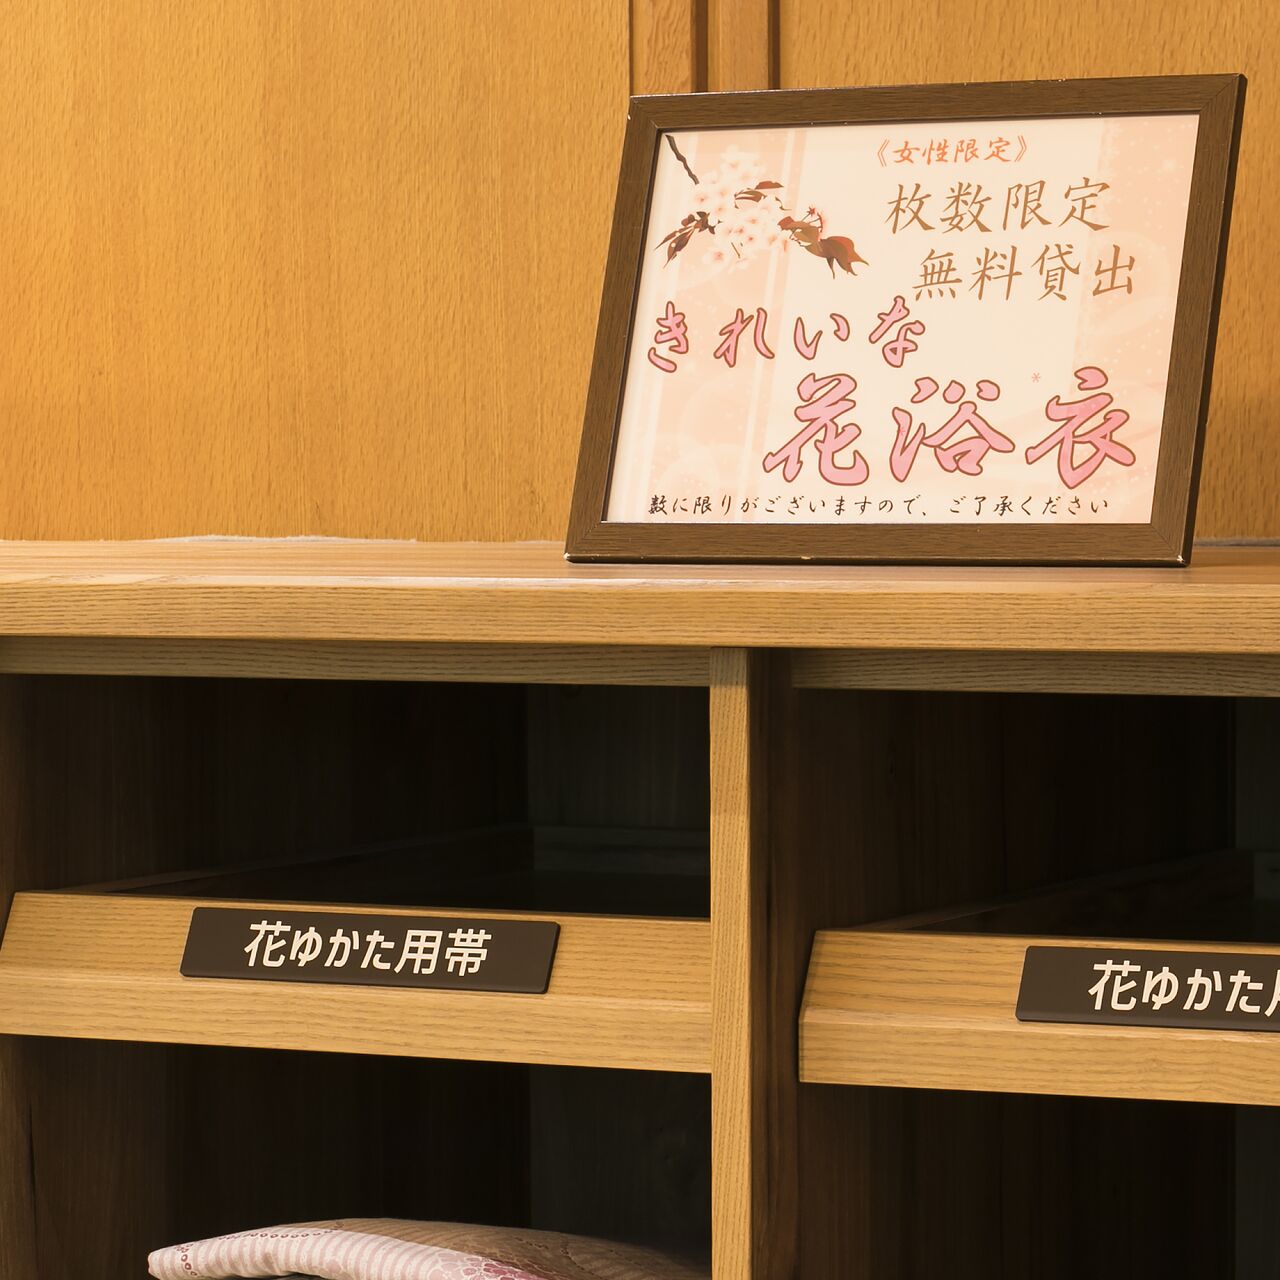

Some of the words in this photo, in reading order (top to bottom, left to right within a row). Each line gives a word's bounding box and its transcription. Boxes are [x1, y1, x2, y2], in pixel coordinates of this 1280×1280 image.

[887, 175, 1111, 235] 枚数限定
[912, 243, 1136, 301] 無料貸出
[647, 295, 927, 373] きれいな
[763, 366, 1136, 489] 花浴衣
[244, 920, 492, 977] 花ゆかた用帯
